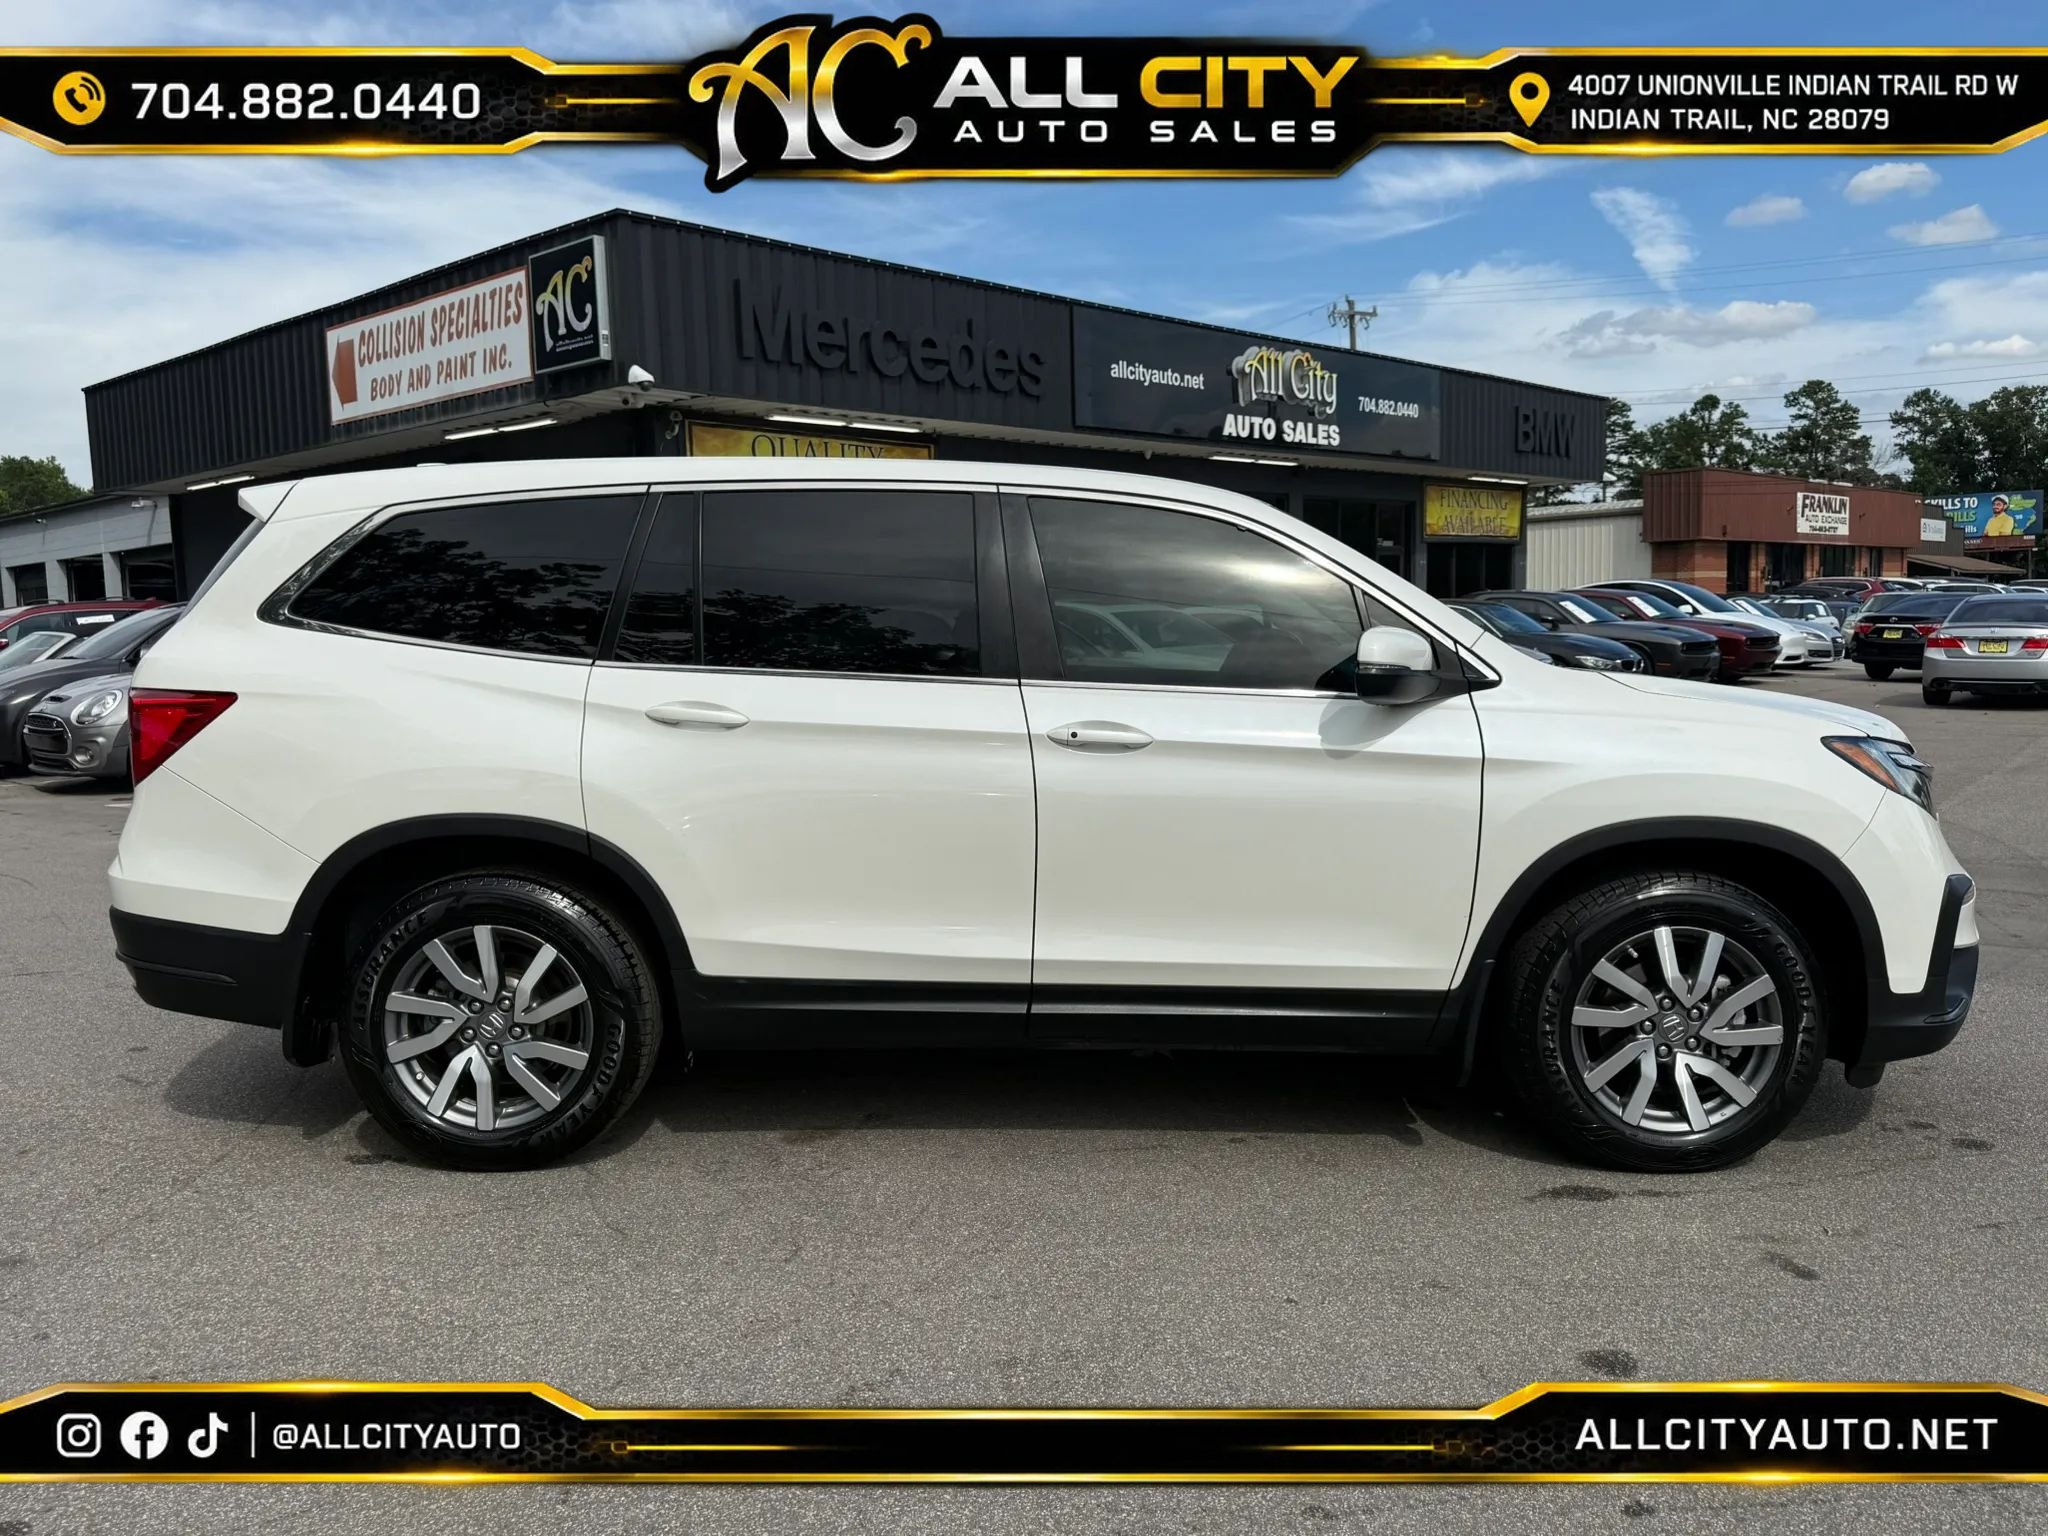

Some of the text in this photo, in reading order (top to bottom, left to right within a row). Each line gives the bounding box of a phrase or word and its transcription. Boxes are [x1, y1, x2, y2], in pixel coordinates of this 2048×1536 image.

[358, 281, 523, 368] COLLISION SPECIALTIES
[733, 278, 1045, 398] Mercedes
[370, 343, 513, 401] BODY AND PAINT INC.
[1110, 360, 1205, 390] allcityauto.net
[1244, 348, 1339, 414] All City
[1357, 396, 1419, 418] 704.882.0440
[1222, 413, 1340, 447] AUTO SALES
[1514, 405, 1576, 459] BMW
[751, 434, 884, 458] QUALITY
[1440, 489, 1509, 510] FINANCING
[1801, 494, 1848, 518] FRANKLIN
[1963, 497, 1978, 508] TO
[1442, 515, 1507, 534] AVAILABLE
[1806, 514, 1848, 526] AUTO EXCHANGE
